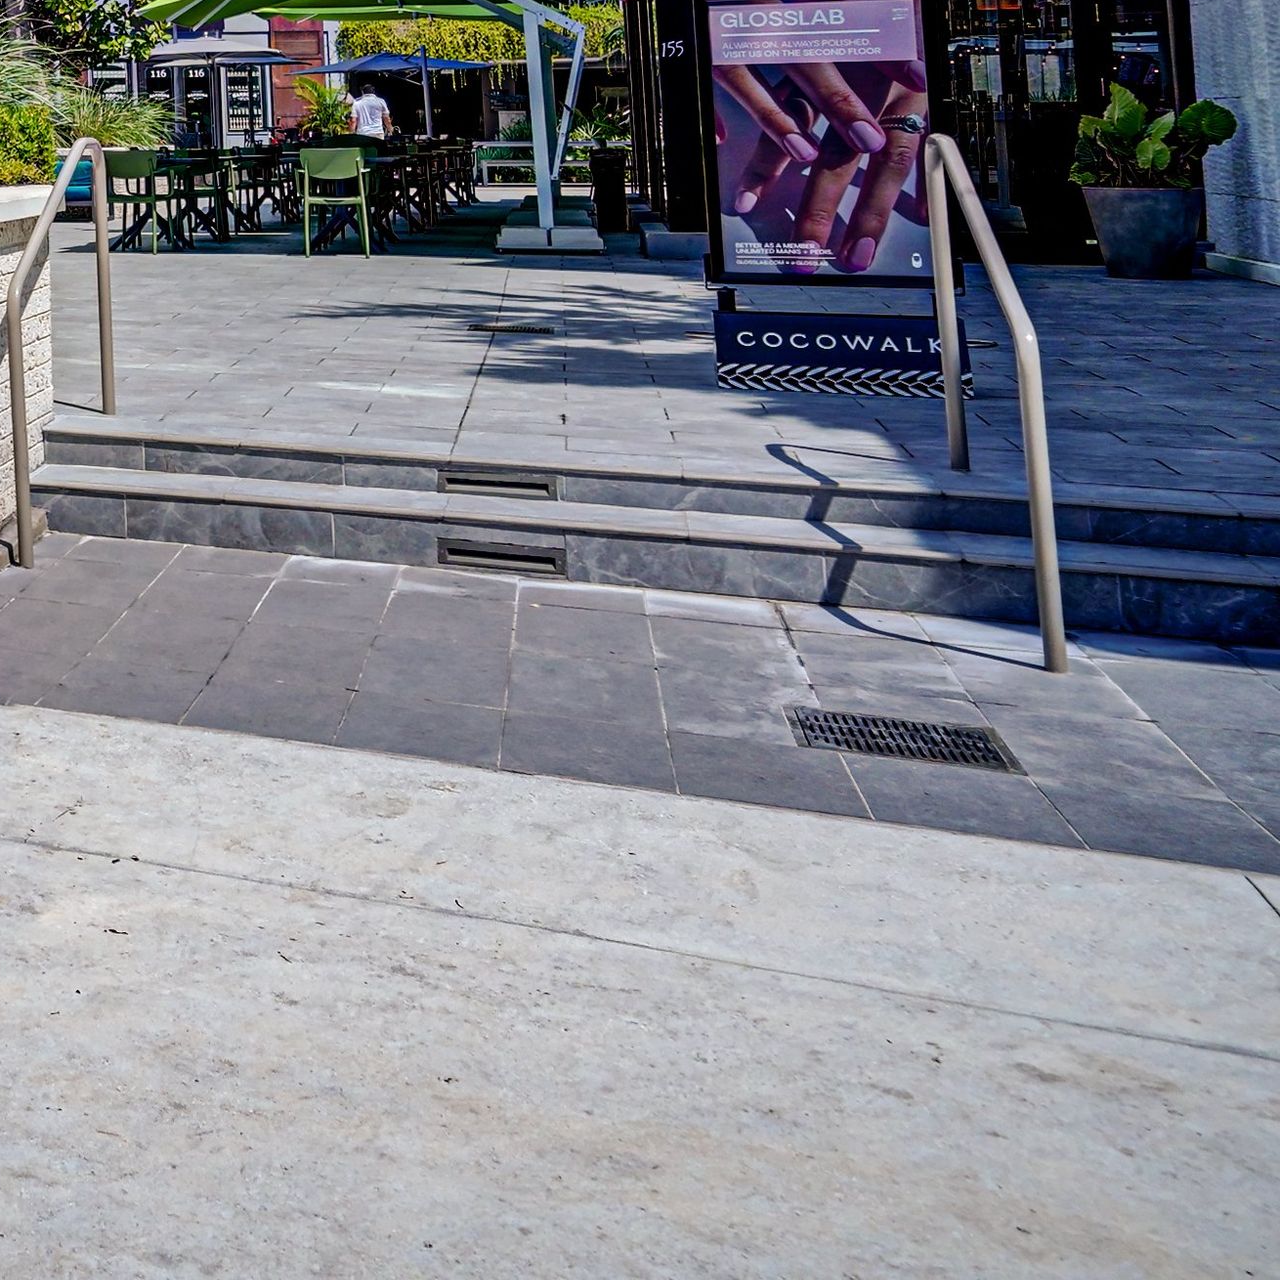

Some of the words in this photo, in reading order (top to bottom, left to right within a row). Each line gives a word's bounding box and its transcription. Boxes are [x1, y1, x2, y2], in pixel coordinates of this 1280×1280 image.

[720, 8, 846, 29] GLOSSLAB
[661, 40, 684, 58] 155
[722, 40, 761, 50] ALWAYS
[781, 39, 820, 49] ALWAYS
[722, 50, 746, 59] VISIT
[748, 50, 763, 58] US
[763, 49, 780, 58] ON
[781, 49, 801, 57] THE
[803, 48, 847, 57] SECOND
[848, 47, 882, 56] FLOOR
[150, 69, 167, 78] 116
[188, 69, 205, 78] 116
[736, 330, 943, 354] COCOWALK
